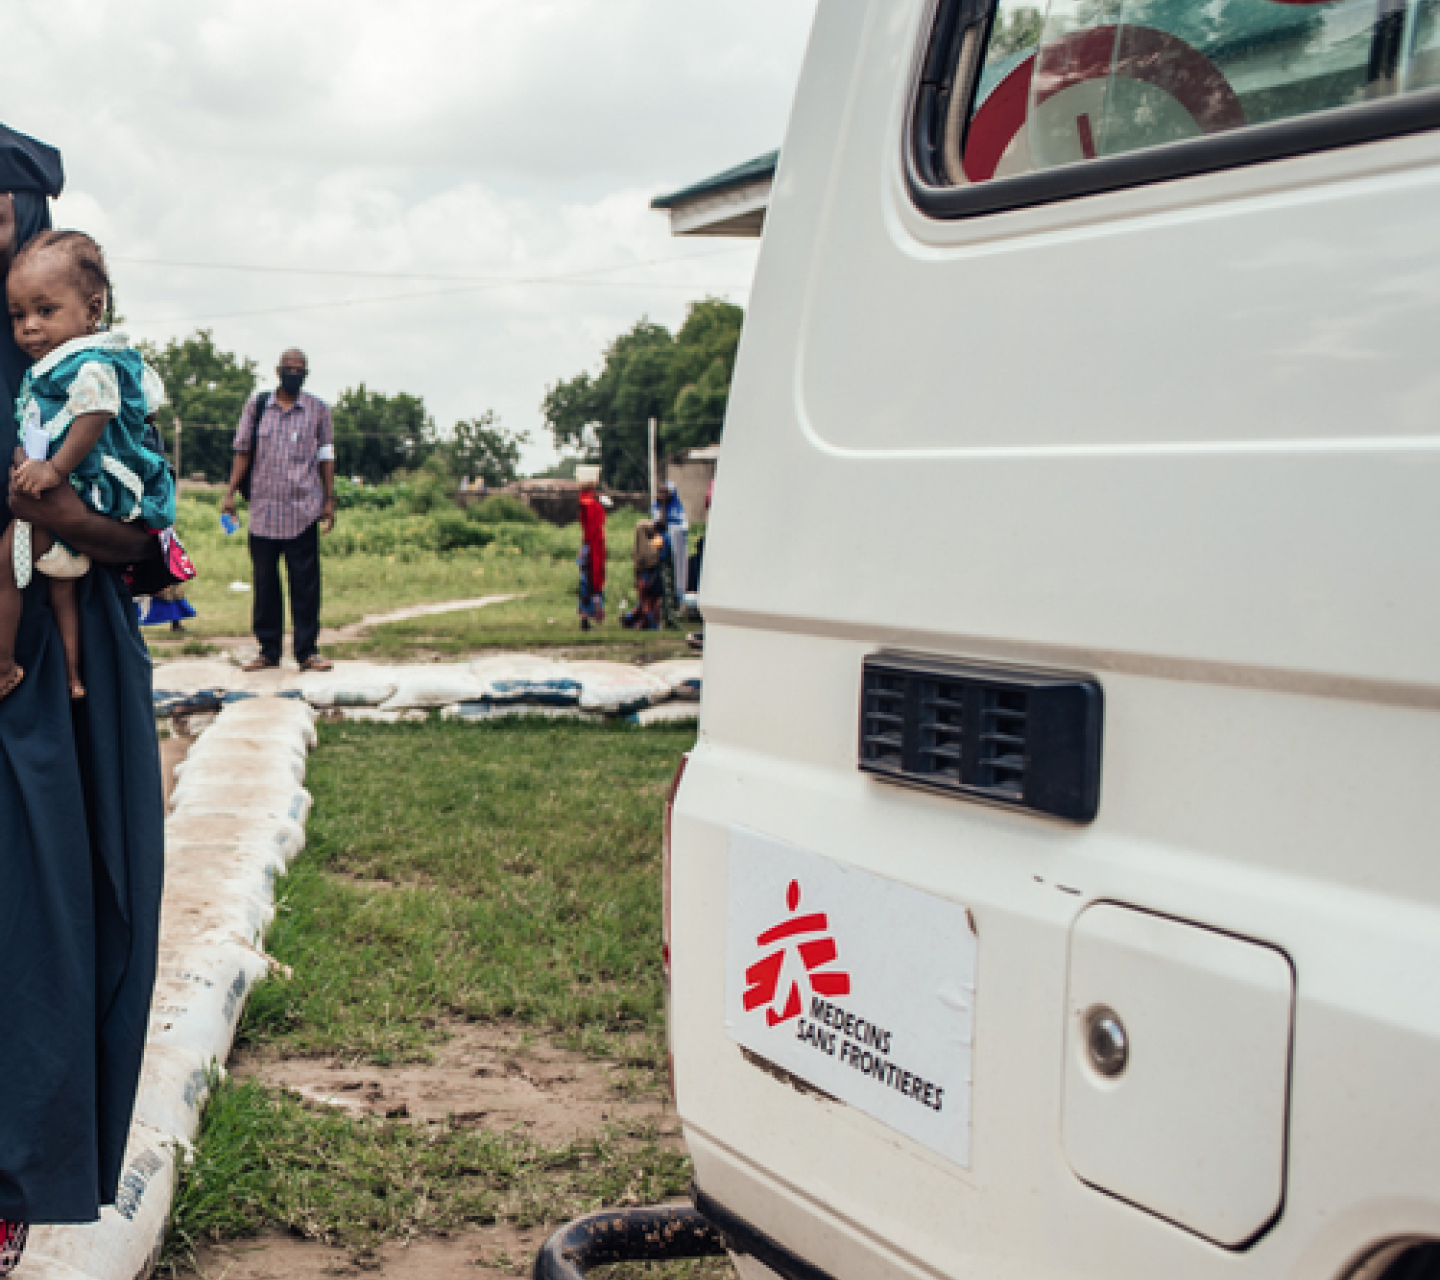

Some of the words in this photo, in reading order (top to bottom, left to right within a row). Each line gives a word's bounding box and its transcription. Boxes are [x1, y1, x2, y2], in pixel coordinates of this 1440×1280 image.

[810, 996, 892, 1054] MEDECINS
[796, 1017, 837, 1056] SANS
[839, 1039, 944, 1112] FRONTIERES
